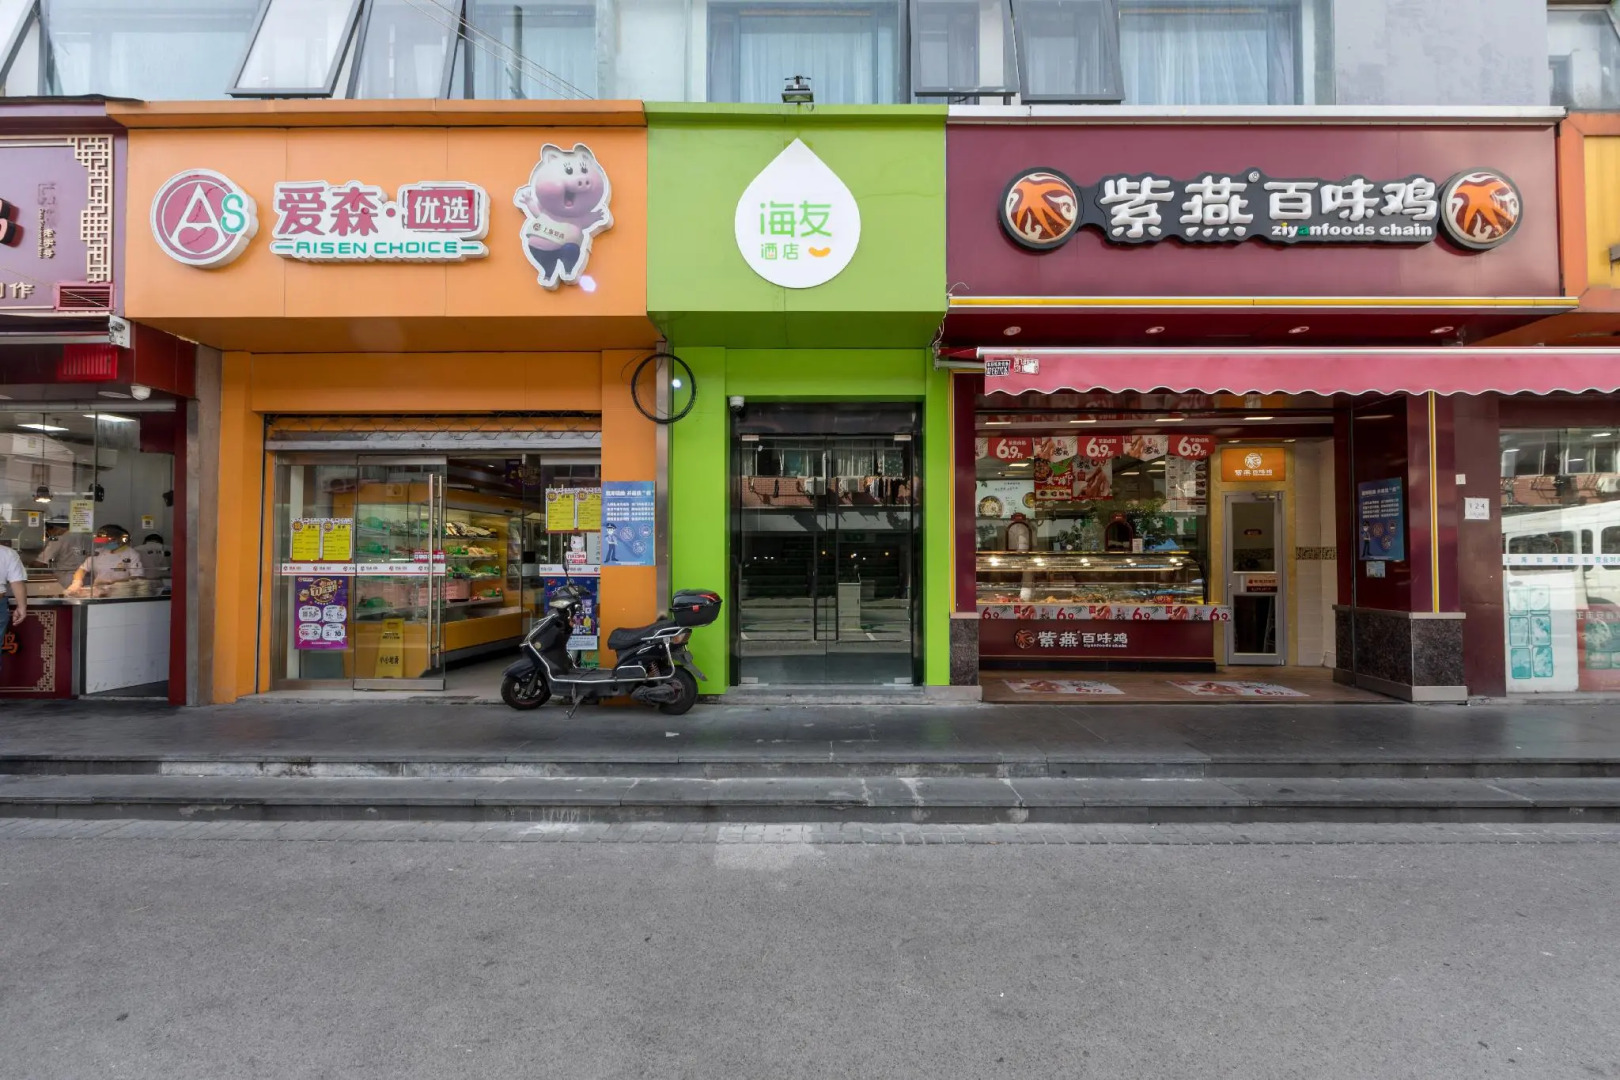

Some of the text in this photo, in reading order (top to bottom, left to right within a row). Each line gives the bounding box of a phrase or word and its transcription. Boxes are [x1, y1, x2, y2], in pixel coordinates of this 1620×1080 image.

[413, 195, 470, 224] 优选
[760, 201, 832, 237] 海友
[1271, 222, 1433, 237] ziyanfoods chain
[374, 241, 457, 254] CHOICE
[761, 243, 799, 260] 酒店
[0, 282, 35, 299] 作
